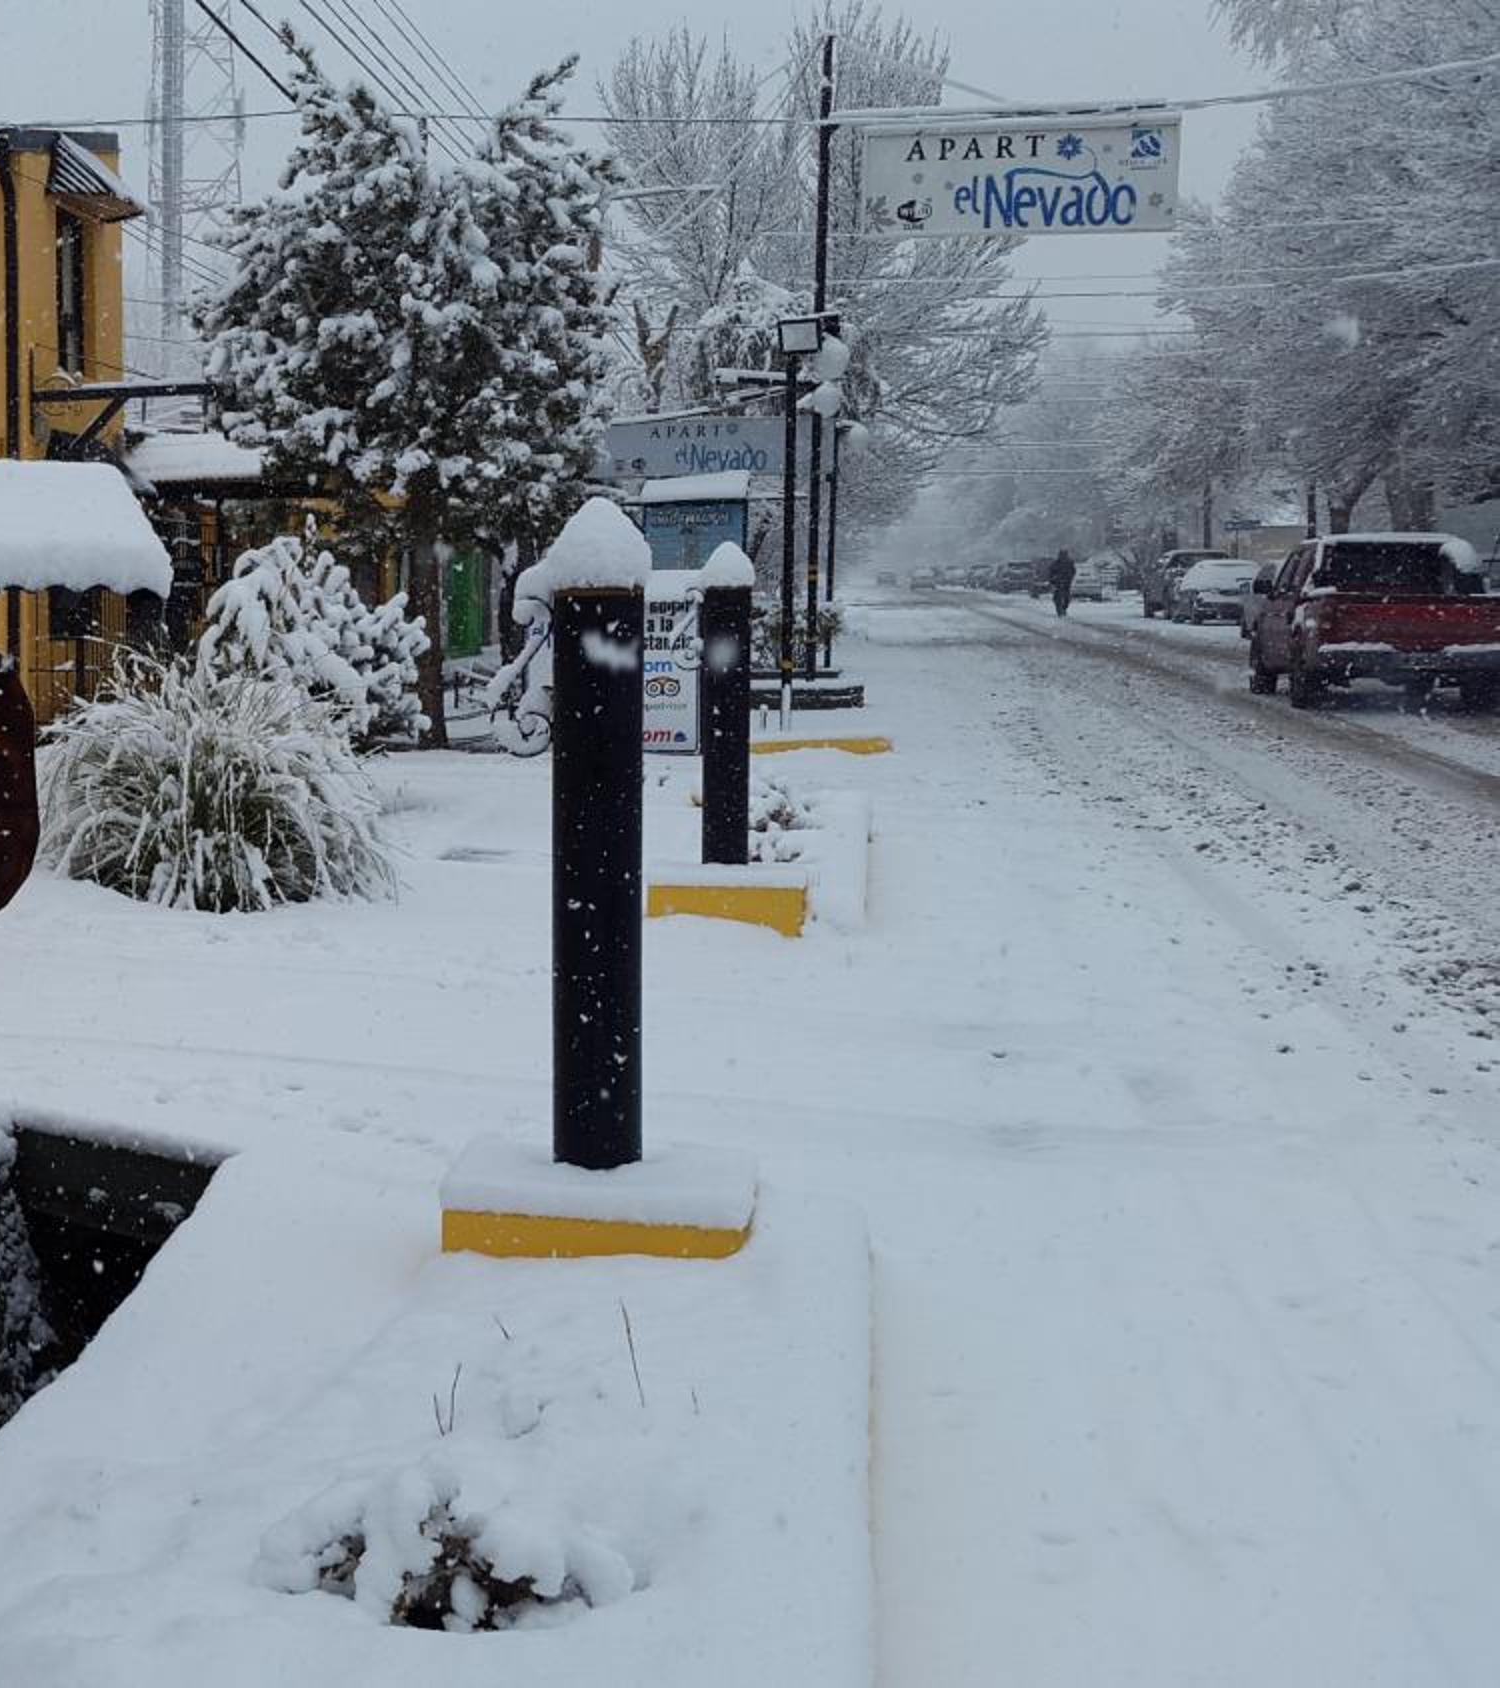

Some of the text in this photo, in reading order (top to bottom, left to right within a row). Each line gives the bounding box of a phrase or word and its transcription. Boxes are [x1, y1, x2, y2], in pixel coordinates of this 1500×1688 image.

[904, 133, 1046, 162] APART
[650, 424, 720, 439] APART
[647, 616, 674, 633] a la
